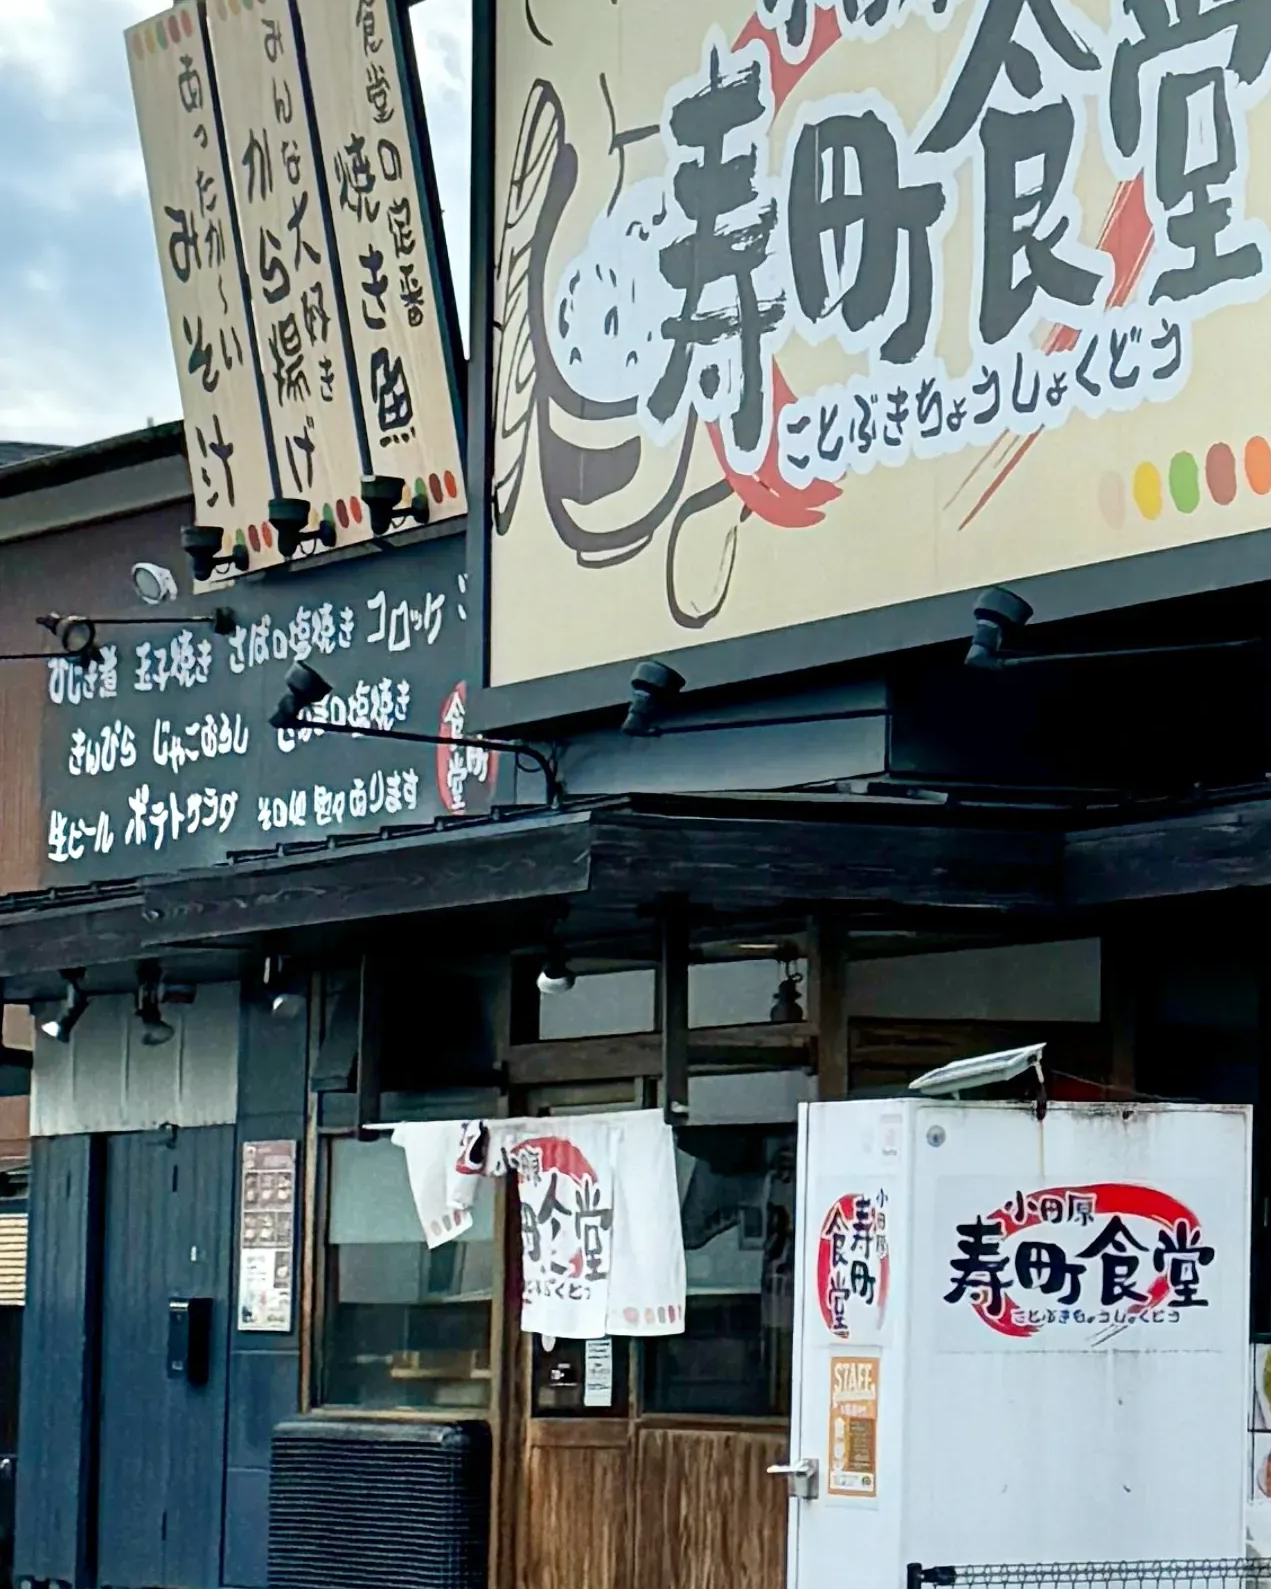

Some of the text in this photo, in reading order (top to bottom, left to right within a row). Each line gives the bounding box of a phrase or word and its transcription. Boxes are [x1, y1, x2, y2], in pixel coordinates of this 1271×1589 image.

[261, 18, 334, 402] みんな大好き
[242, 127, 315, 492] から揚げ
[334, 132, 415, 448] 焼き魚
[164, 205, 235, 507] みそ汁
[786, 321, 1183, 468] ことぶきちょうしょくどう
[134, 628, 212, 692] 玉子焼き
[228, 602, 354, 674] さばの塩焼き
[367, 590, 446, 652] コロッケ
[153, 712, 248, 774] じゃこおろし
[48, 809, 114, 862] 生ビール
[125, 784, 238, 850] ポテトサラダ
[943, 1214, 1215, 1316] 寿町食堂
[1004, 1190, 1095, 1227] 小田原
